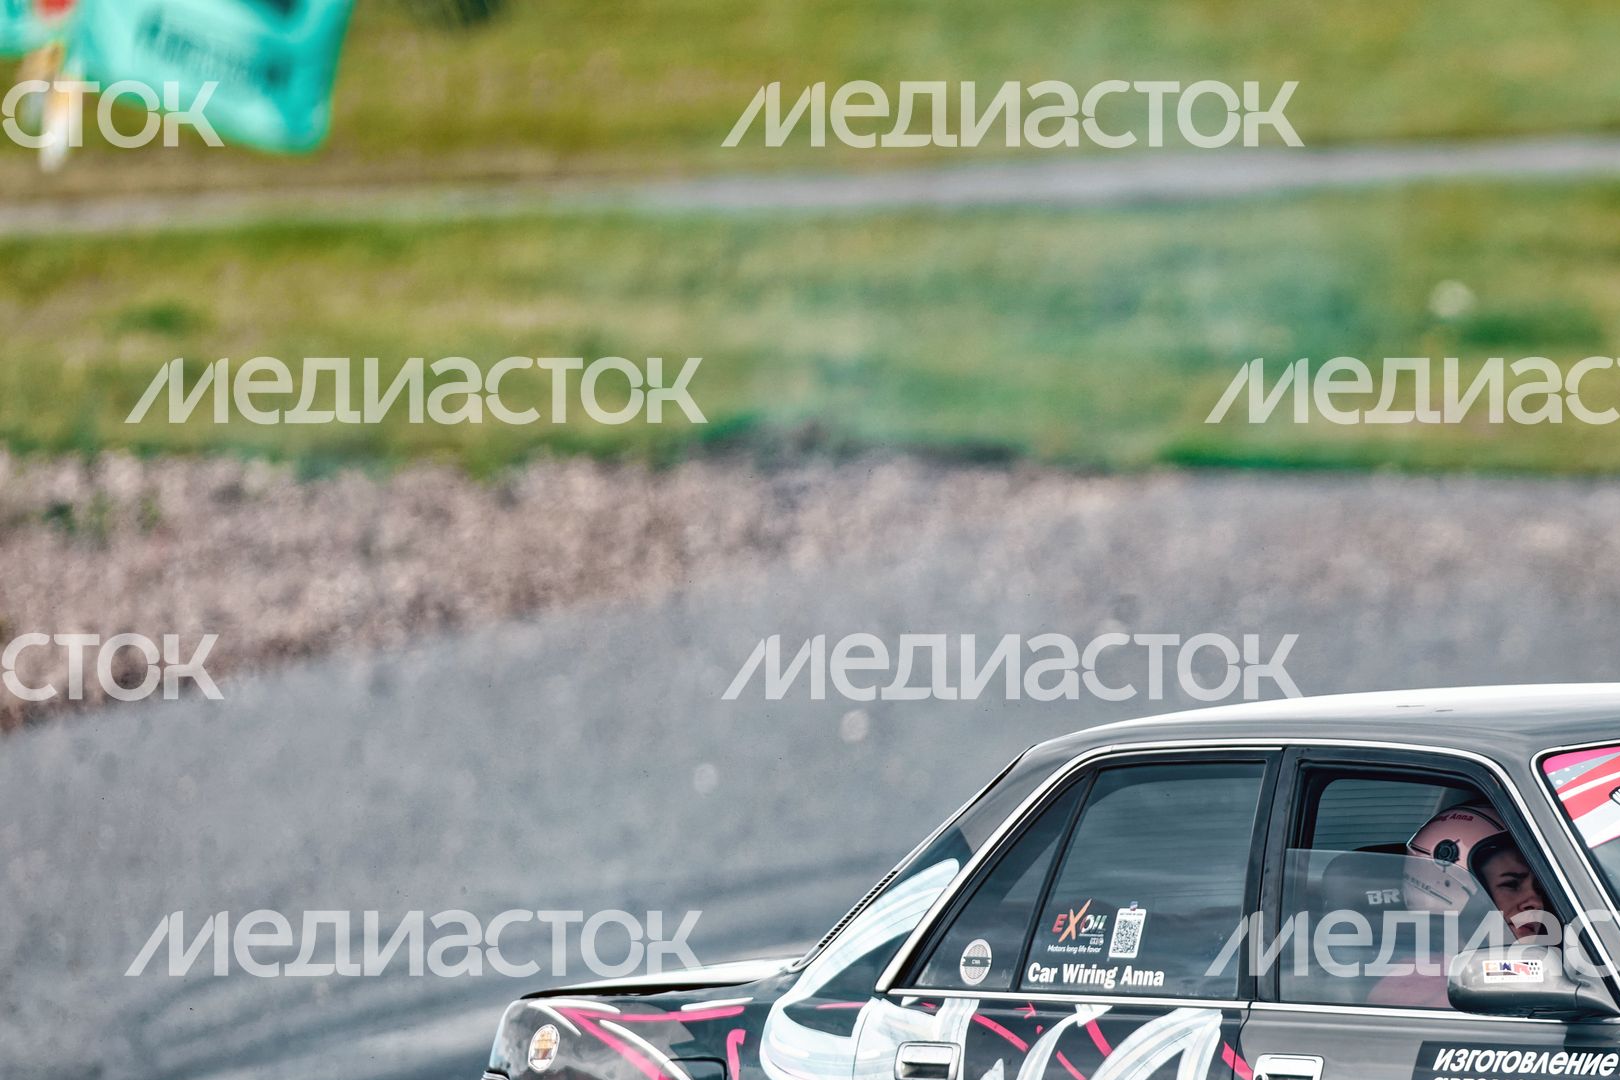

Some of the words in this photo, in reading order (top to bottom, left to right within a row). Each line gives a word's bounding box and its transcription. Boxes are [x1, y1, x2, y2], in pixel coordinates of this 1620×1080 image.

[1028, 963, 1058, 984] Car
[1062, 963, 1118, 989] Wiring
[1120, 966, 1165, 987] Anna
